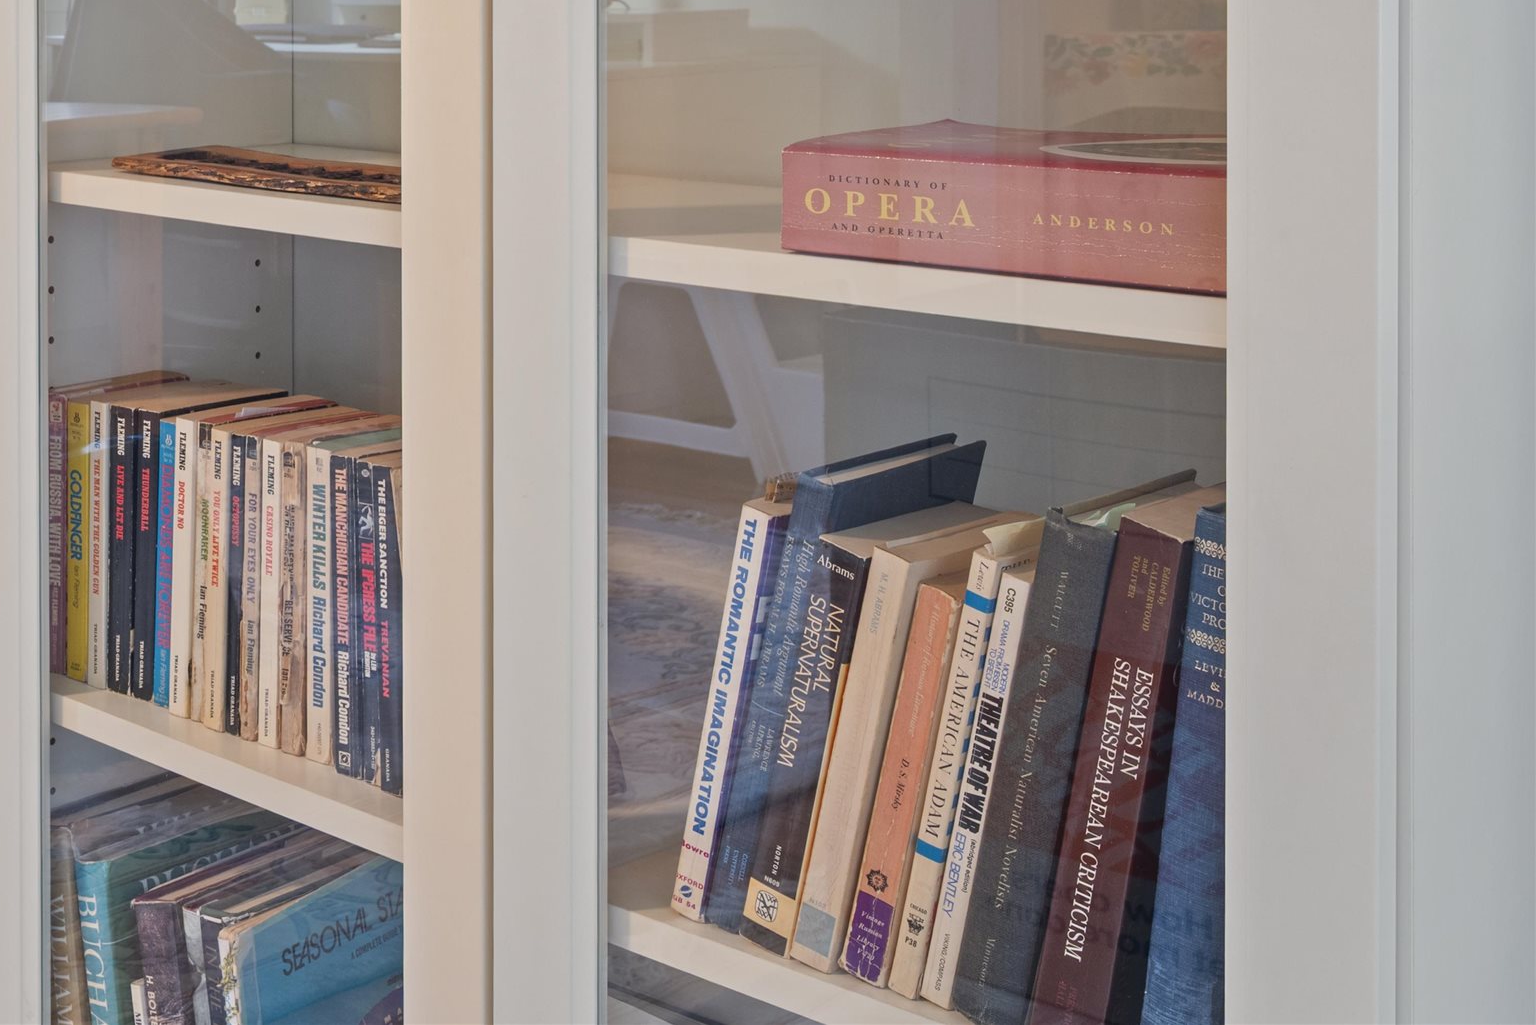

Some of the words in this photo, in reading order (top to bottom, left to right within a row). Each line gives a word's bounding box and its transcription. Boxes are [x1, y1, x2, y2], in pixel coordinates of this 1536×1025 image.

[828, 173, 920, 189] DICTIONARY
[930, 181, 948, 191] OF
[804, 187, 976, 227] OPERA
[1033, 212, 1177, 237] ANDERSON
[831, 222, 859, 233] AND
[868, 224, 945, 240] OPERETTA
[93, 410, 101, 449] FLEMING
[116, 417, 126, 456] FLEMING
[142, 419, 151, 459] FLEMING
[178, 431, 187, 471] FLEMING
[214, 440, 222, 480] FLEMING
[232, 445, 241, 487] FLEMING
[267, 454, 275, 495] FLEMING
[334, 468, 347, 493] THE
[140, 468, 151, 532] THUNDERBALL
[160, 464, 175, 549] DIAMONDS
[248, 493, 257, 513] FOR
[312, 484, 326, 542] WINTER
[377, 478, 387, 505] THE
[69, 469, 83, 561] GOLDFINGER
[200, 498, 210, 562] MOONRAKER
[231, 495, 240, 548] OCTOPUSSY
[247, 516, 257, 544] YOUR
[265, 505, 274, 538] CASINO
[335, 493, 348, 575] MANCHURIAN
[377, 506, 387, 541] EIGER
[247, 547, 257, 575] EYES
[265, 541, 274, 576] ROYALE
[361, 542, 374, 566] THE
[739, 518, 758, 563] THE
[312, 543, 327, 591] KILLS
[378, 542, 389, 610] SANCTION
[816, 553, 855, 581] Abrams
[975, 560, 990, 592] Lewis
[1126, 554, 1141, 600] TOLIVER
[246, 575, 256, 604] ONLY
[336, 577, 350, 646] CANDIDATE
[1004, 587, 1016, 614] C395
[1141, 560, 1159, 633] CALDERWOOD
[157, 581, 172, 650] FOREVER
[196, 603, 208, 640] Fleming
[312, 596, 327, 654] Richard
[717, 565, 750, 686] ROMANTIC
[380, 620, 390, 698] TREVANIAN
[812, 602, 846, 694] NATURAL
[962, 618, 982, 662] THE
[312, 655, 327, 709] Condon
[337, 650, 350, 698] Richard
[776, 593, 828, 768] SUPERNATURALISM
[1037, 644, 1058, 688] Seven
[337, 699, 350, 745] Condon
[939, 666, 971, 776] AMERICAN
[1023, 694, 1048, 764] American
[1124, 665, 1155, 751] ESSAYS
[970, 691, 1004, 772] THEATRE
[1084, 656, 1132, 851] SHAKESPEAREAN
[692, 687, 729, 836] IMAGINATION
[966, 766, 990, 796] OF
[1119, 751, 1142, 781] IN
[890, 782, 905, 811] Mirsky
[925, 778, 948, 839] ADAM
[958, 791, 987, 835] WAR
[1010, 769, 1032, 846] Naturalist
[770, 844, 782, 876] NORTON
[952, 831, 967, 860] ERIC
[763, 875, 781, 888] N609
[941, 859, 962, 919] BENTLEY
[994, 844, 1017, 911] Novelists
[909, 903, 928, 915] CHICAGO
[1063, 851, 1100, 963] CRITICISM
[281, 906, 373, 977] SEASONAL
[904, 935, 918, 948] P38
[975, 936, 996, 988] Minnesota
